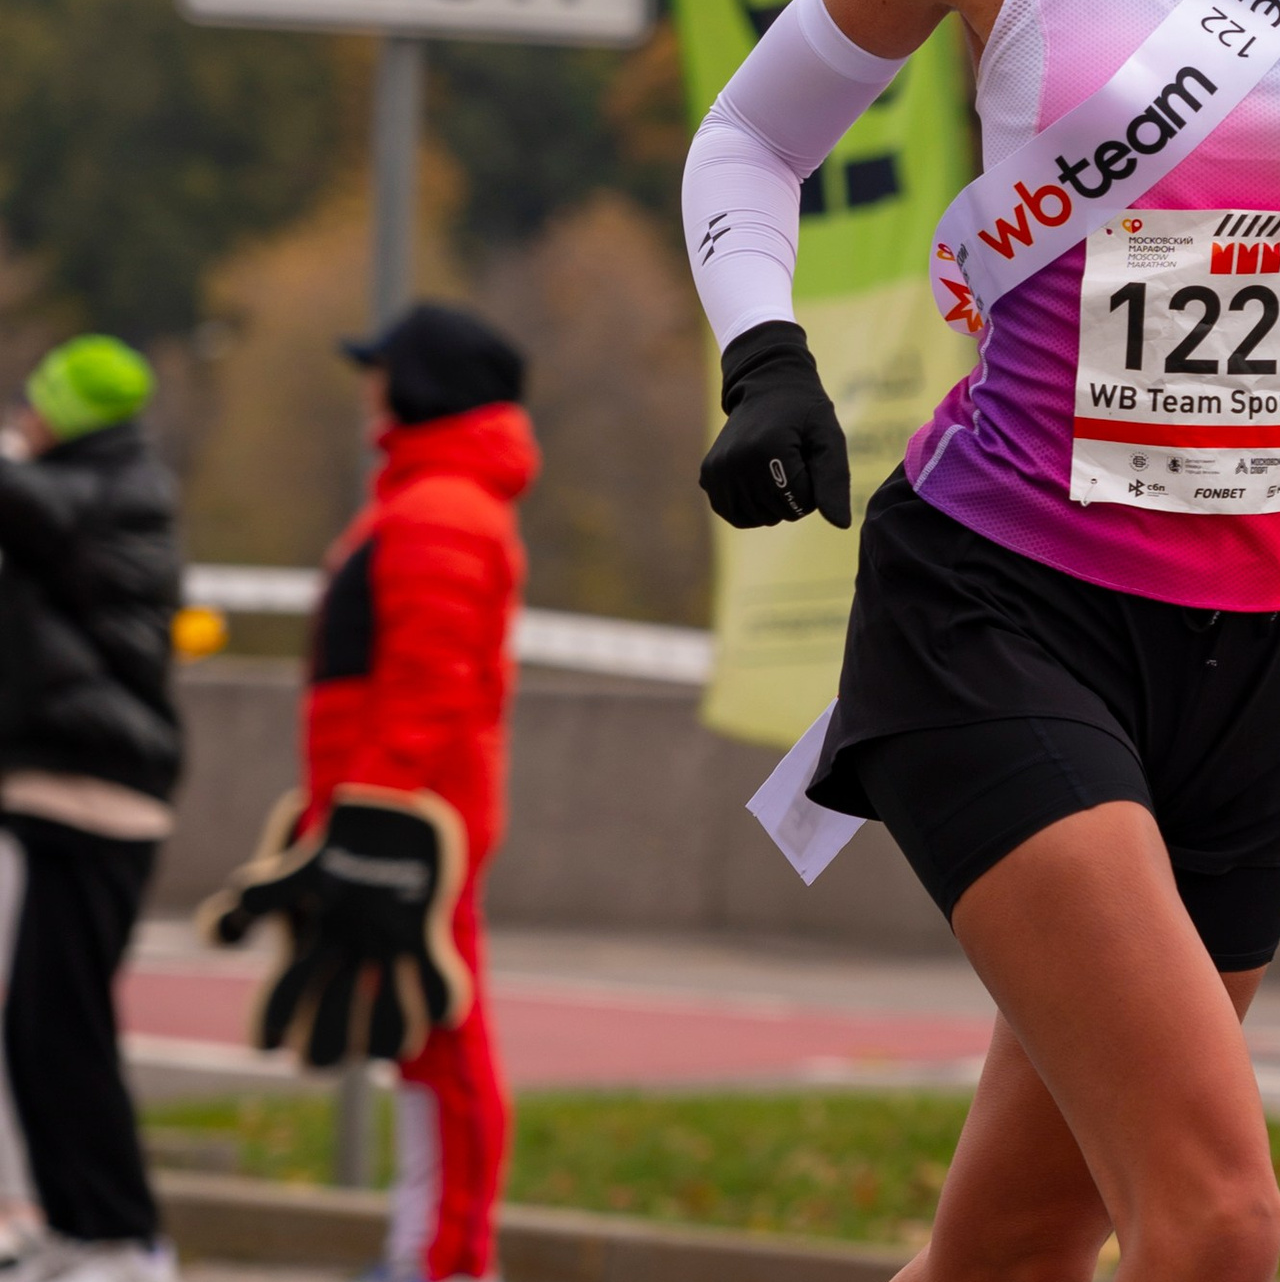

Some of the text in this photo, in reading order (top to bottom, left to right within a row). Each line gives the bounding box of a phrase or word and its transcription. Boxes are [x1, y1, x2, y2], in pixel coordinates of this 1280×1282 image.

[977, 65, 1219, 260] wbteam
[1128, 236, 1194, 245] МОСКОВСКИЙ
[1128, 245, 1176, 253] МАРАФОН
[1127, 253, 1170, 261] MOSCOW
[1089, 382, 1137, 410] WB
[1148, 388, 1222, 414] Team
[1193, 487, 1247, 499] FONBET
